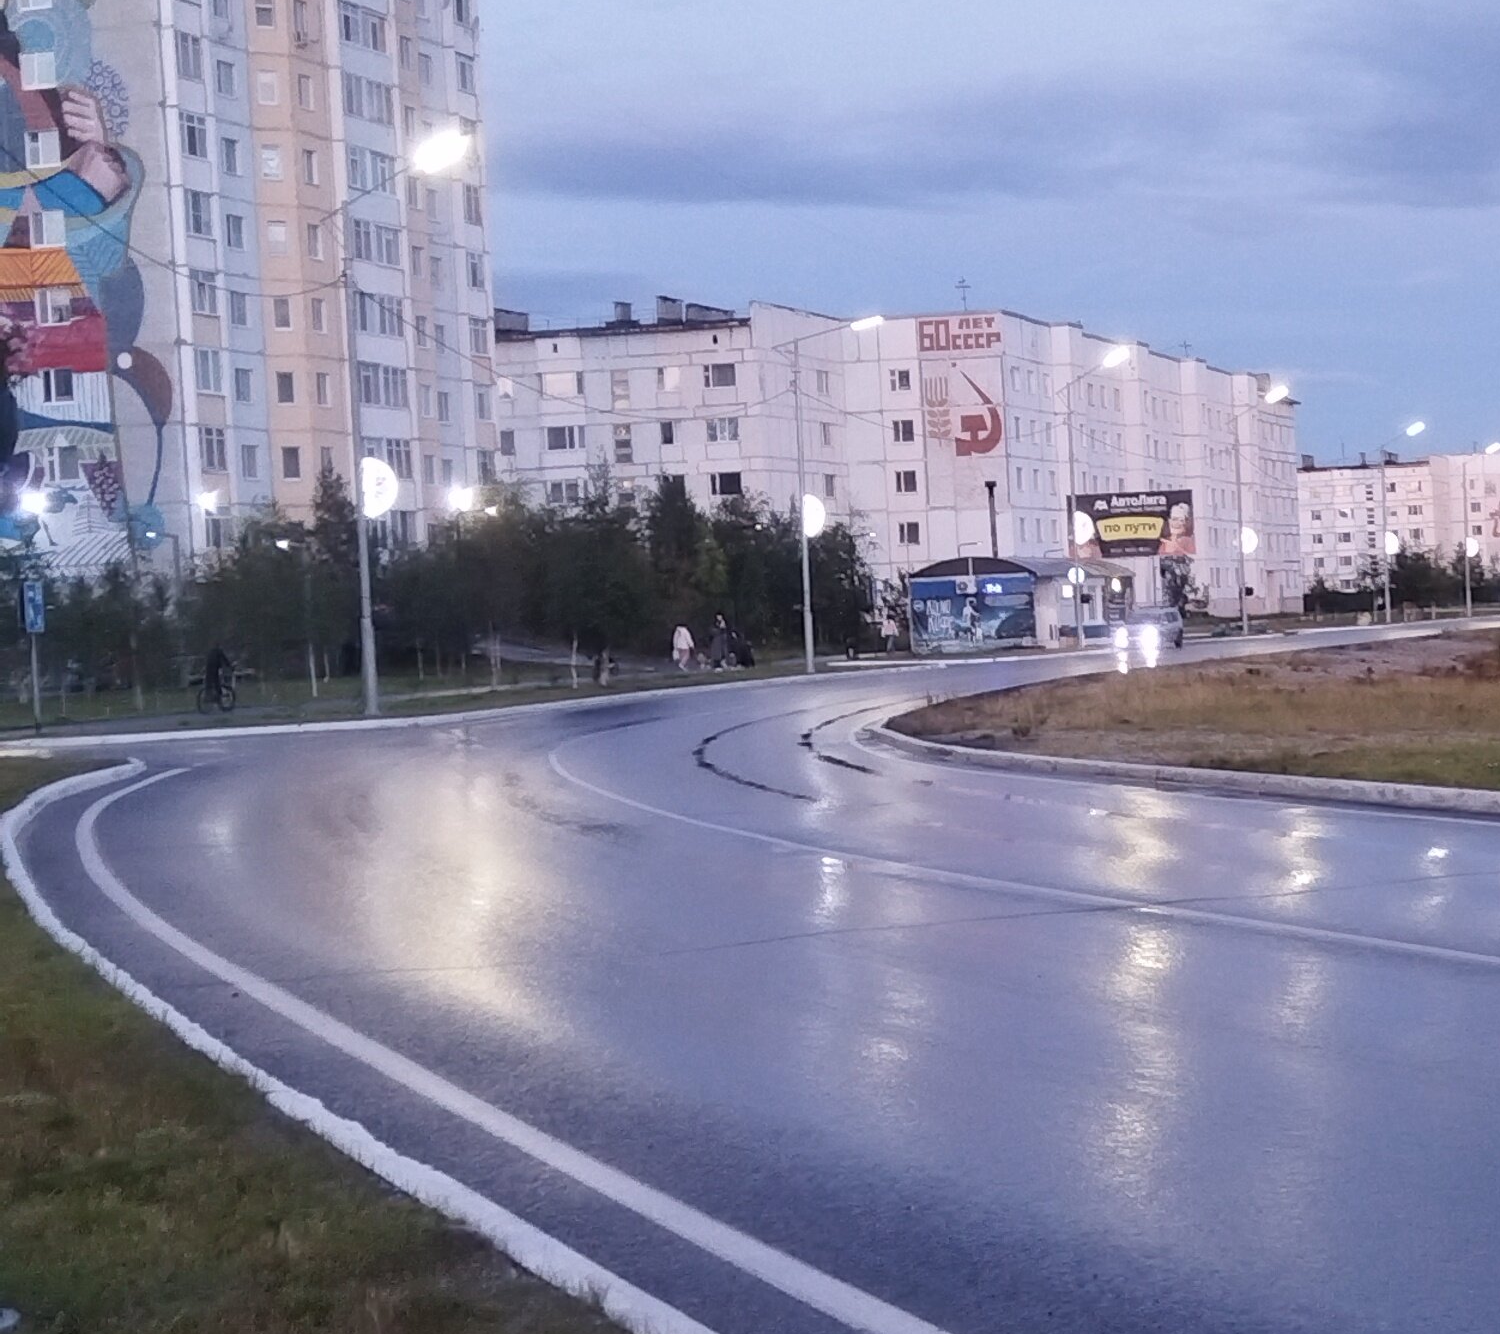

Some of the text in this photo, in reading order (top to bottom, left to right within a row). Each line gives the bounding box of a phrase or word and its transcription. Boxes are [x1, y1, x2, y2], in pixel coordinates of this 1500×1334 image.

[919, 317, 995, 352] 60 ЛЕТ
[951, 332, 1001, 350] СССР
